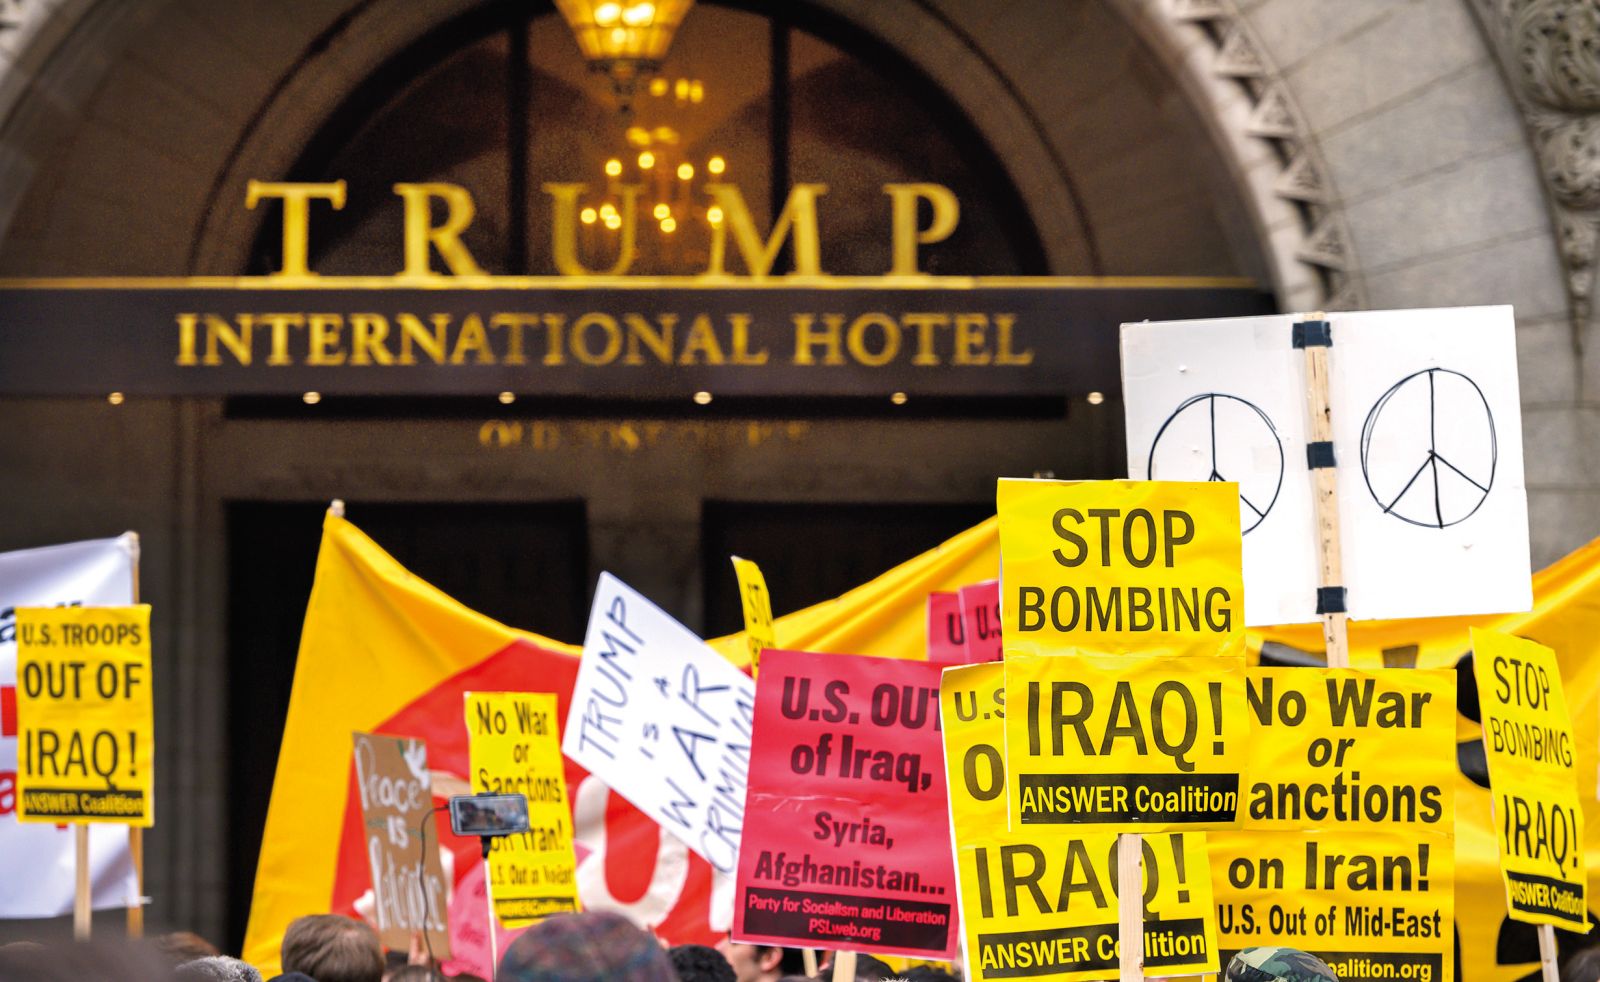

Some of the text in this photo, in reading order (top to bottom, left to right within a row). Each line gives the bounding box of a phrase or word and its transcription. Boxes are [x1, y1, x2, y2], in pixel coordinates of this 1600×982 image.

[246, 180, 961, 277] TRUMP
[177, 312, 1034, 366] INTERNATIONAL HOTEL
[1052, 508, 1195, 568] STOP
[1018, 586, 1232, 632] BOMBING
[22, 623, 56, 645] U.S.
[62, 623, 142, 646] TROOPS
[24, 662, 143, 699] OUT OF
[579, 596, 645, 760] TRUMP
[653, 676, 671, 699] A
[780, 676, 858, 724] U.S.
[1493, 656, 1550, 711] STOP
[477, 701, 548, 735] No War
[1246, 677, 1432, 729] No War
[638, 722, 659, 760] IS
[660, 663, 731, 829] WAR
[1027, 680, 1225, 772] IRAQ!
[1490, 716, 1573, 768] BOMBING
[26, 729, 137, 790] IRAQ!
[513, 743, 531, 764] or
[791, 733, 833, 776] of
[838, 735, 932, 793] Iraq,
[1307, 737, 1355, 768] or
[25, 791, 79, 813] ANSWER
[81, 793, 143, 815] Coalition
[1021, 785, 1237, 814] ANSWER Coalition
[1250, 771, 1443, 824] anctions
[813, 811, 894, 850] Syria,
[1503, 794, 1578, 879] IRAQ!
[754, 850, 945, 895] Afghanistan...
[975, 833, 1190, 921] IRAQ!
[1228, 841, 1431, 891] on Iran!
[748, 894, 946, 926] Party for Socialism and Liberation
[1510, 877, 1584, 917] ANSWER Coalition
[808, 918, 881, 940] PSLweb.org
[1219, 904, 1441, 938] U.S. Out of Mid-East
[981, 931, 1206, 970] ANSWER Clition
[1329, 959, 1432, 982] oalition.org
